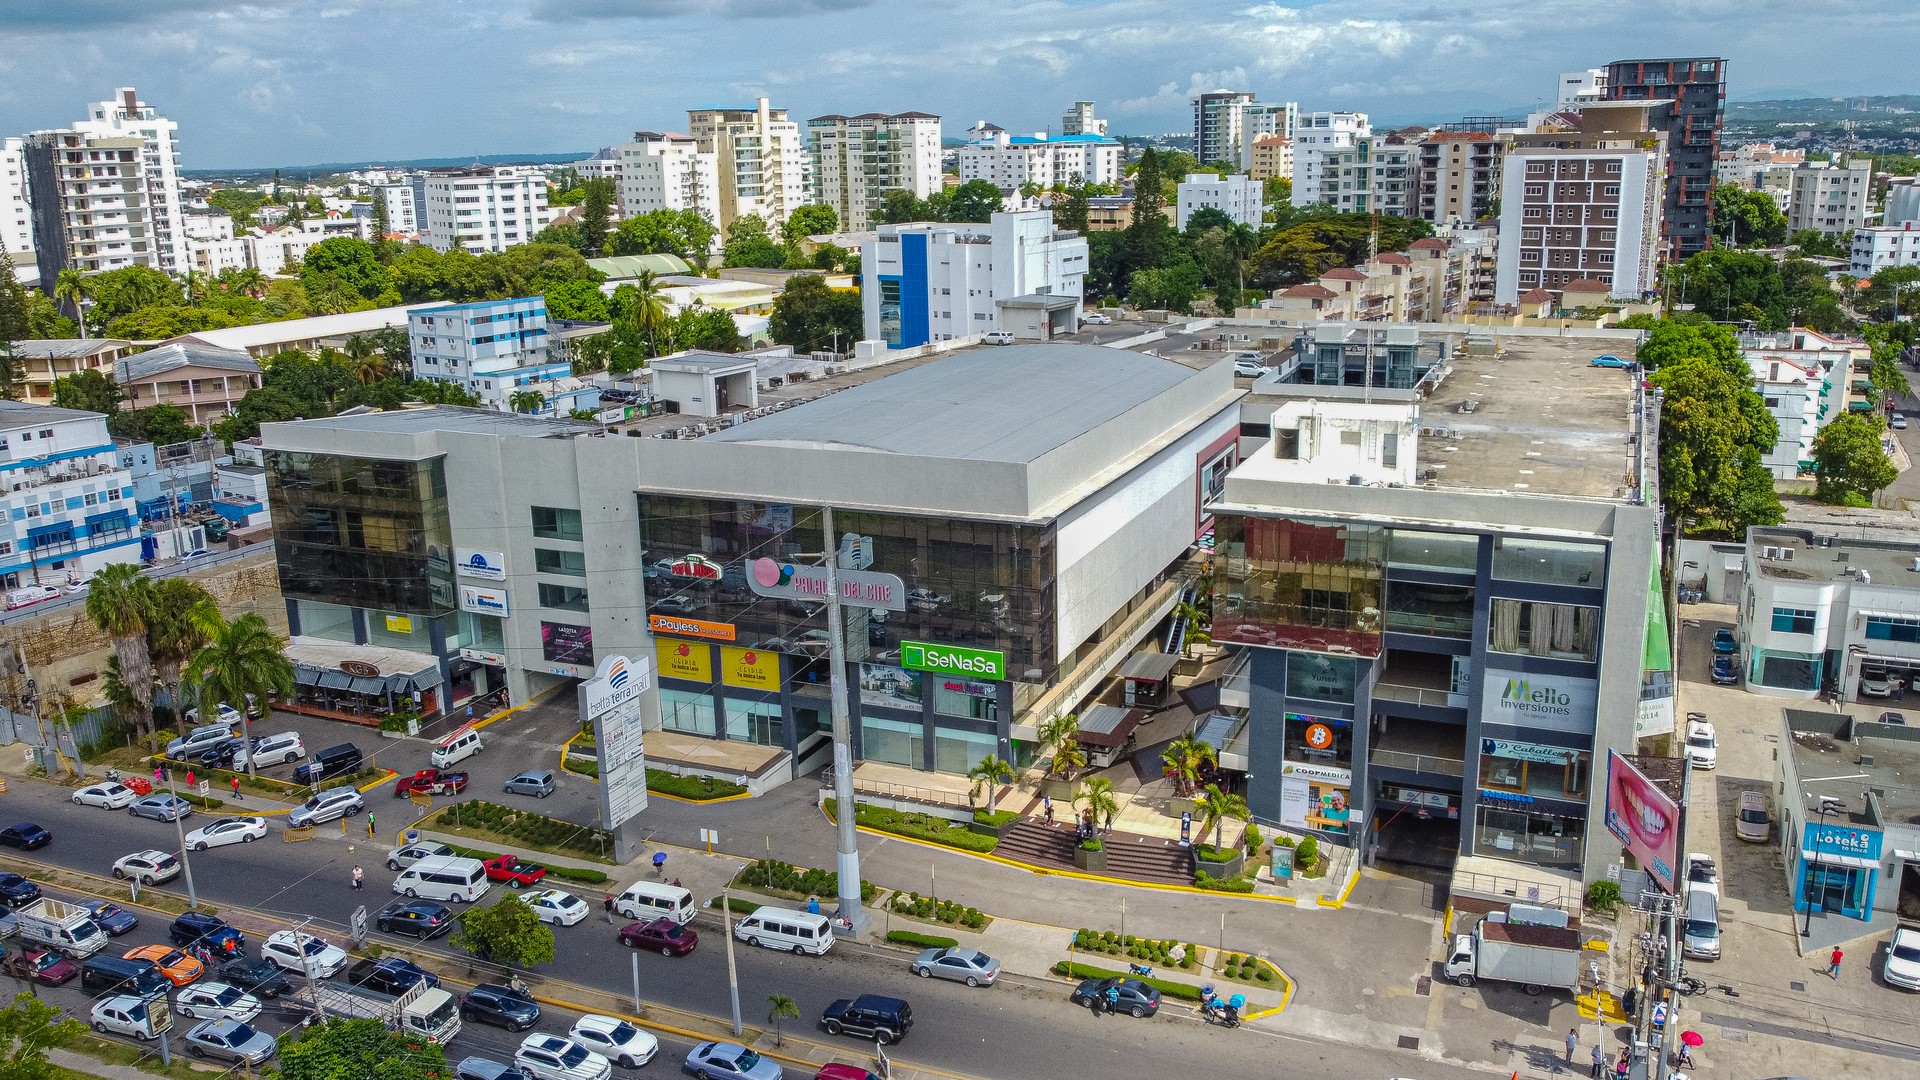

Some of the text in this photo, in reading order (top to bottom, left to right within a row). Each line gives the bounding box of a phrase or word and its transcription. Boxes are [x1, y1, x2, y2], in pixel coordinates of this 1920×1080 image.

[671, 562, 692, 576] PAPA
[843, 581, 863, 599] DEL
[867, 583, 892, 602] CINE
[660, 619, 699, 633] Payless
[349, 663, 369, 676] KGB
[927, 651, 997, 674] SeNaSa
[1311, 674, 1338, 683] Yunen
[590, 696, 611, 715] bella
[611, 686, 631, 704] terra
[631, 676, 648, 694] mall
[1502, 678, 1571, 706] Mello
[1500, 699, 1570, 716] Inversiones
[1296, 767, 1351, 780] COOPMEDICA
[1816, 832, 1869, 849] Loteka
